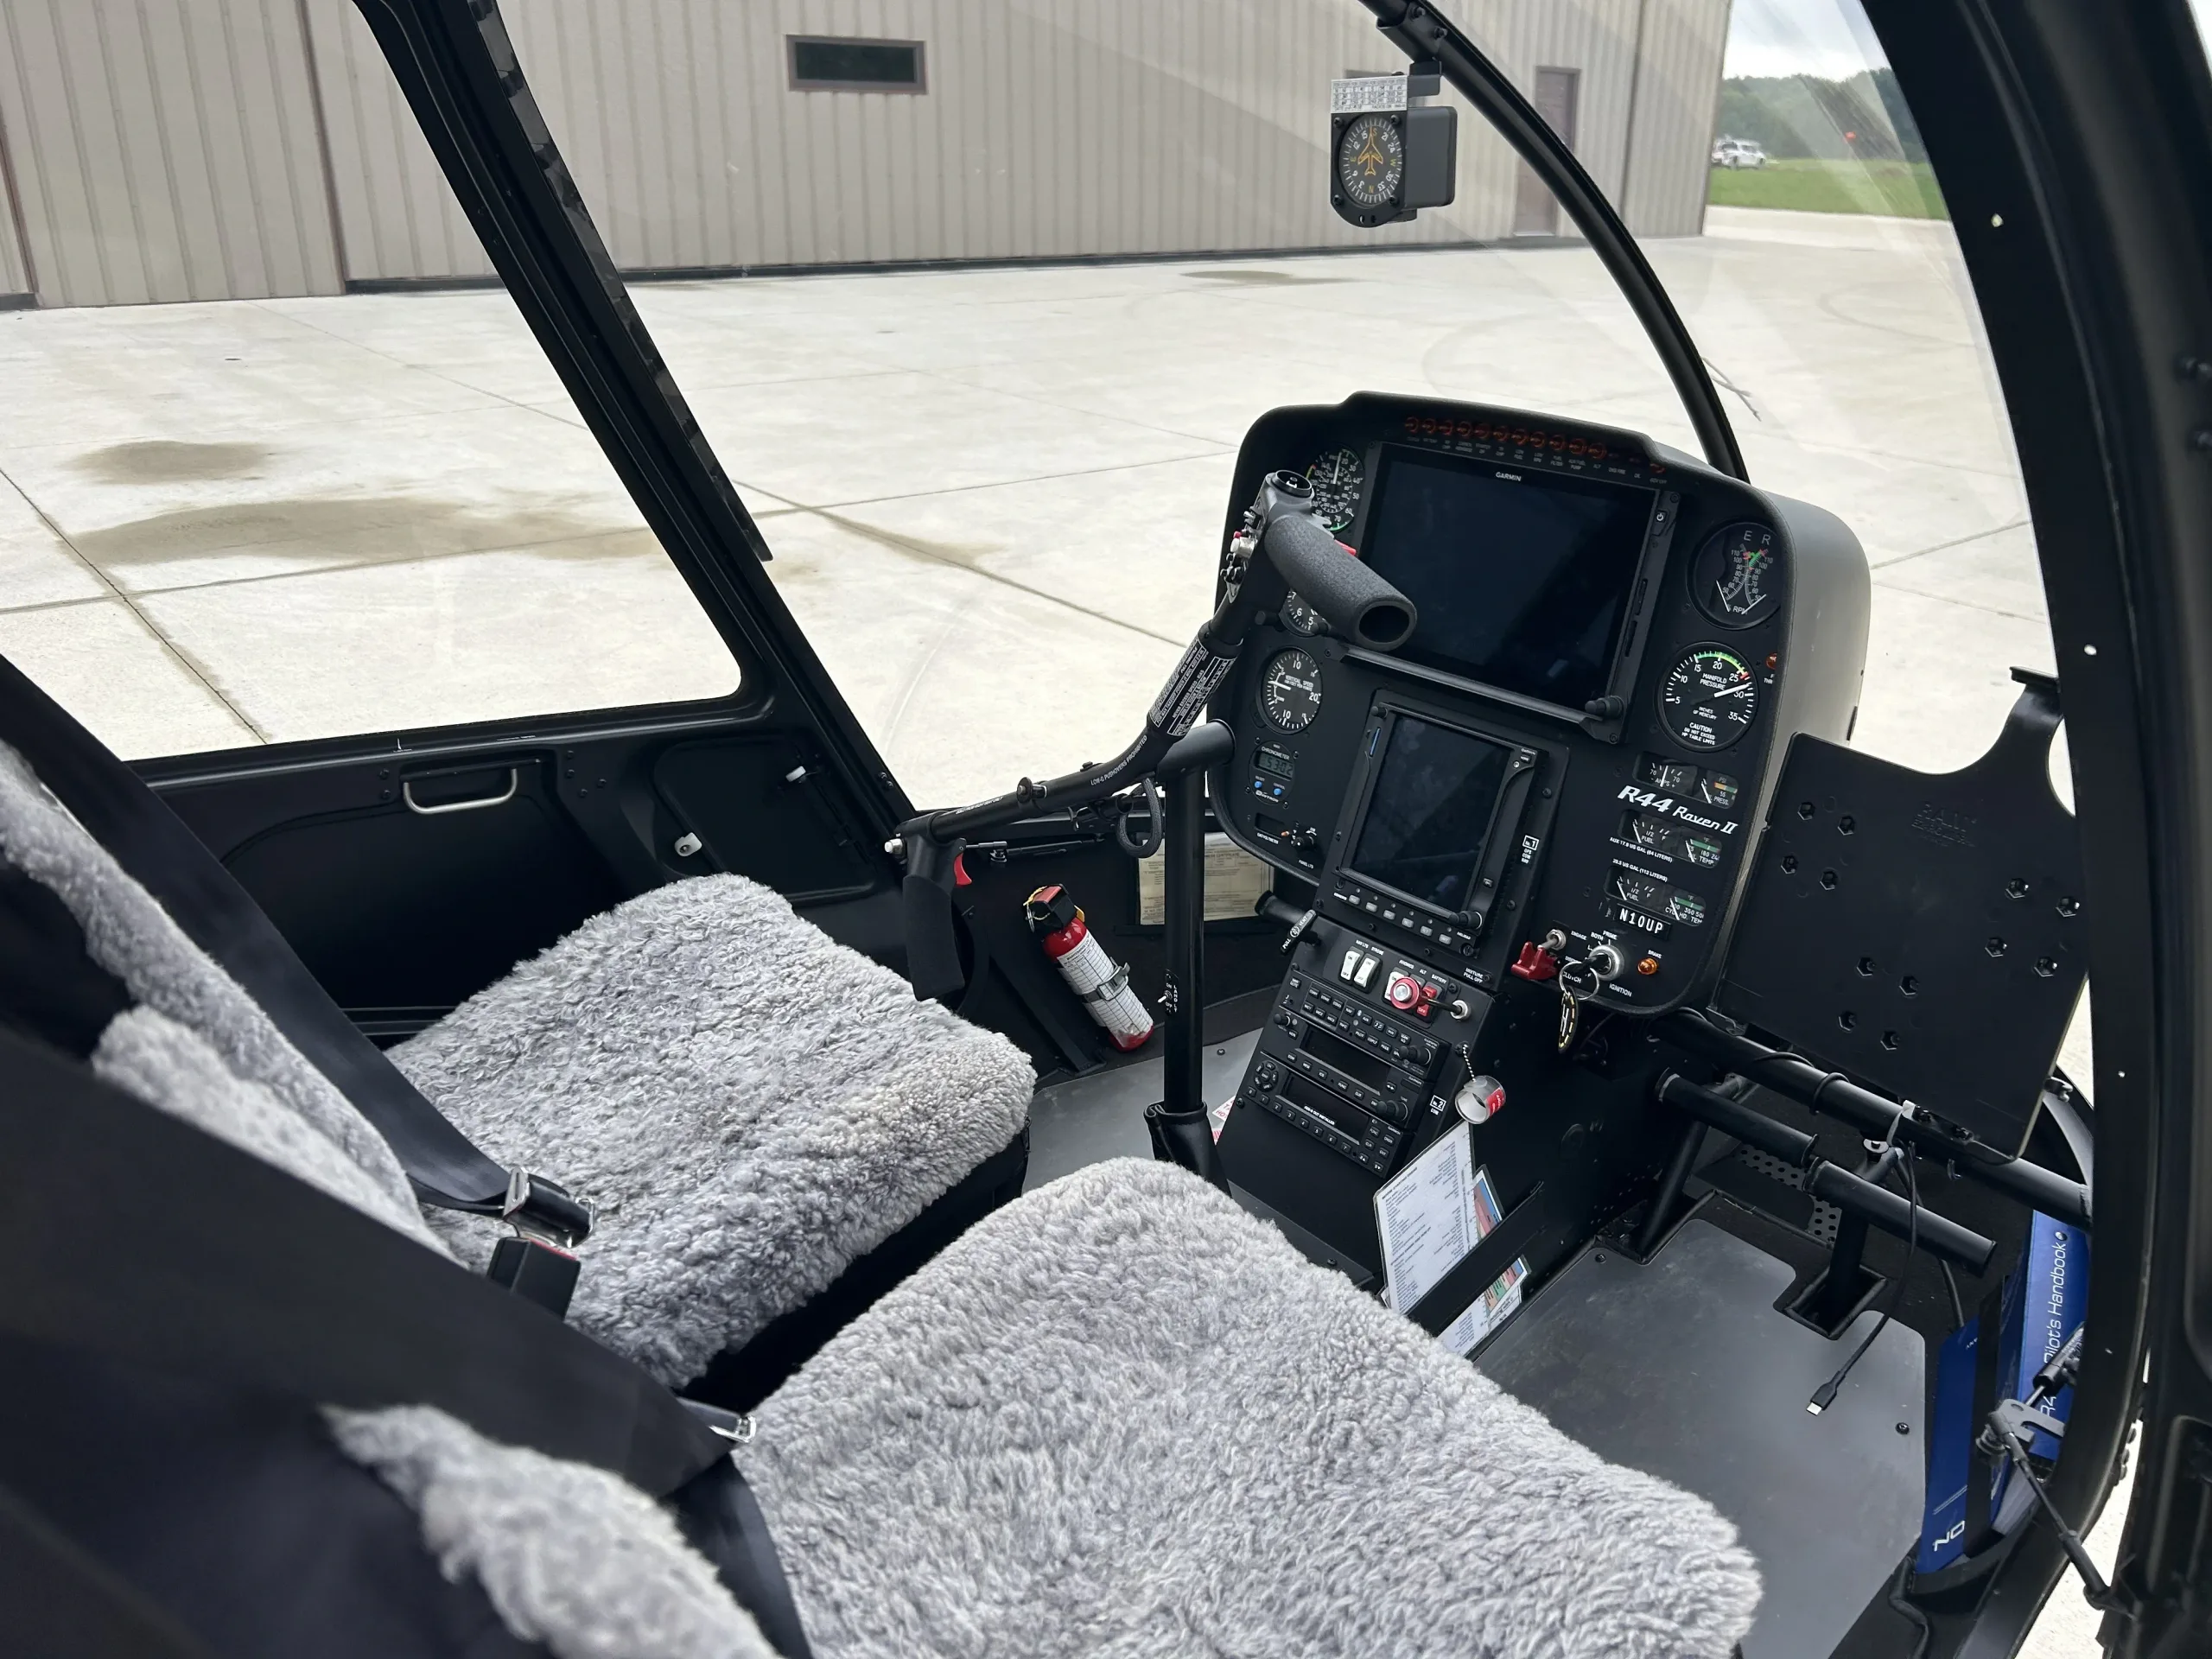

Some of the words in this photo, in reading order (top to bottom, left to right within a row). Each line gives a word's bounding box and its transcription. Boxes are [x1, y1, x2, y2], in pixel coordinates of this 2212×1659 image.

[1372, 128, 1377, 137] S
[1388, 143, 1395, 153] 24
[1386, 171, 1394, 181] 30
[1377, 181, 1386, 191] 33
[1496, 471, 1522, 481] GARMIN
[1744, 530, 1752, 541] E
[1762, 534, 1771, 545] R
[1292, 591, 1297, 600] 7
[1293, 660, 1301, 670] 10
[1713, 661, 1722, 671] 20
[1702, 673, 1727, 683] MANIFOLD
[1729, 673, 1738, 683] 25
[1700, 678, 1726, 690] PRESSURE
[1309, 692, 1319, 702] 20
[1282, 709, 1291, 720] 10
[1699, 711, 1717, 721] MERCURY
[1728, 711, 1738, 721] 35
[1689, 722, 1713, 734] CAUTION
[1127, 734, 1148, 762] PROHIBITED
[1262, 746, 1290, 760] CHRONOMETER
[1618, 785, 1674, 813] R44
[1672, 805, 1720, 830] Raven
[1720, 821, 1738, 835] II
[1641, 836, 1654, 844] FUEL
[1637, 845, 1646, 855] GAL
[1654, 851, 1673, 863] LITERS)
[1649, 872, 1668, 882] LITERS)
[1626, 893, 1638, 901] FUEL
[1299, 915, 1307, 925] VENT
[1619, 907, 1664, 934] N10UP
[1590, 931, 1604, 941] BOTH
[1602, 930, 1618, 940] PRIME
[1282, 938, 1291, 949] PULL
[1371, 946, 1384, 956] STROBE
[1648, 950, 1662, 959] BRAKE
[1399, 959, 1414, 969] AVIONICS
[1464, 972, 1473, 981] PULL
[1473, 976, 1483, 984] OFF
[1465, 967, 1484, 979] MIXTURE
[1431, 974, 1447, 984] BATTERY
[1609, 982, 1632, 997] IGNITION
[1319, 1113, 1335, 1126] INSTALLED
[1387, 1126, 1401, 1135] GARMIN
[2050, 1241, 2066, 1312] Handbook
